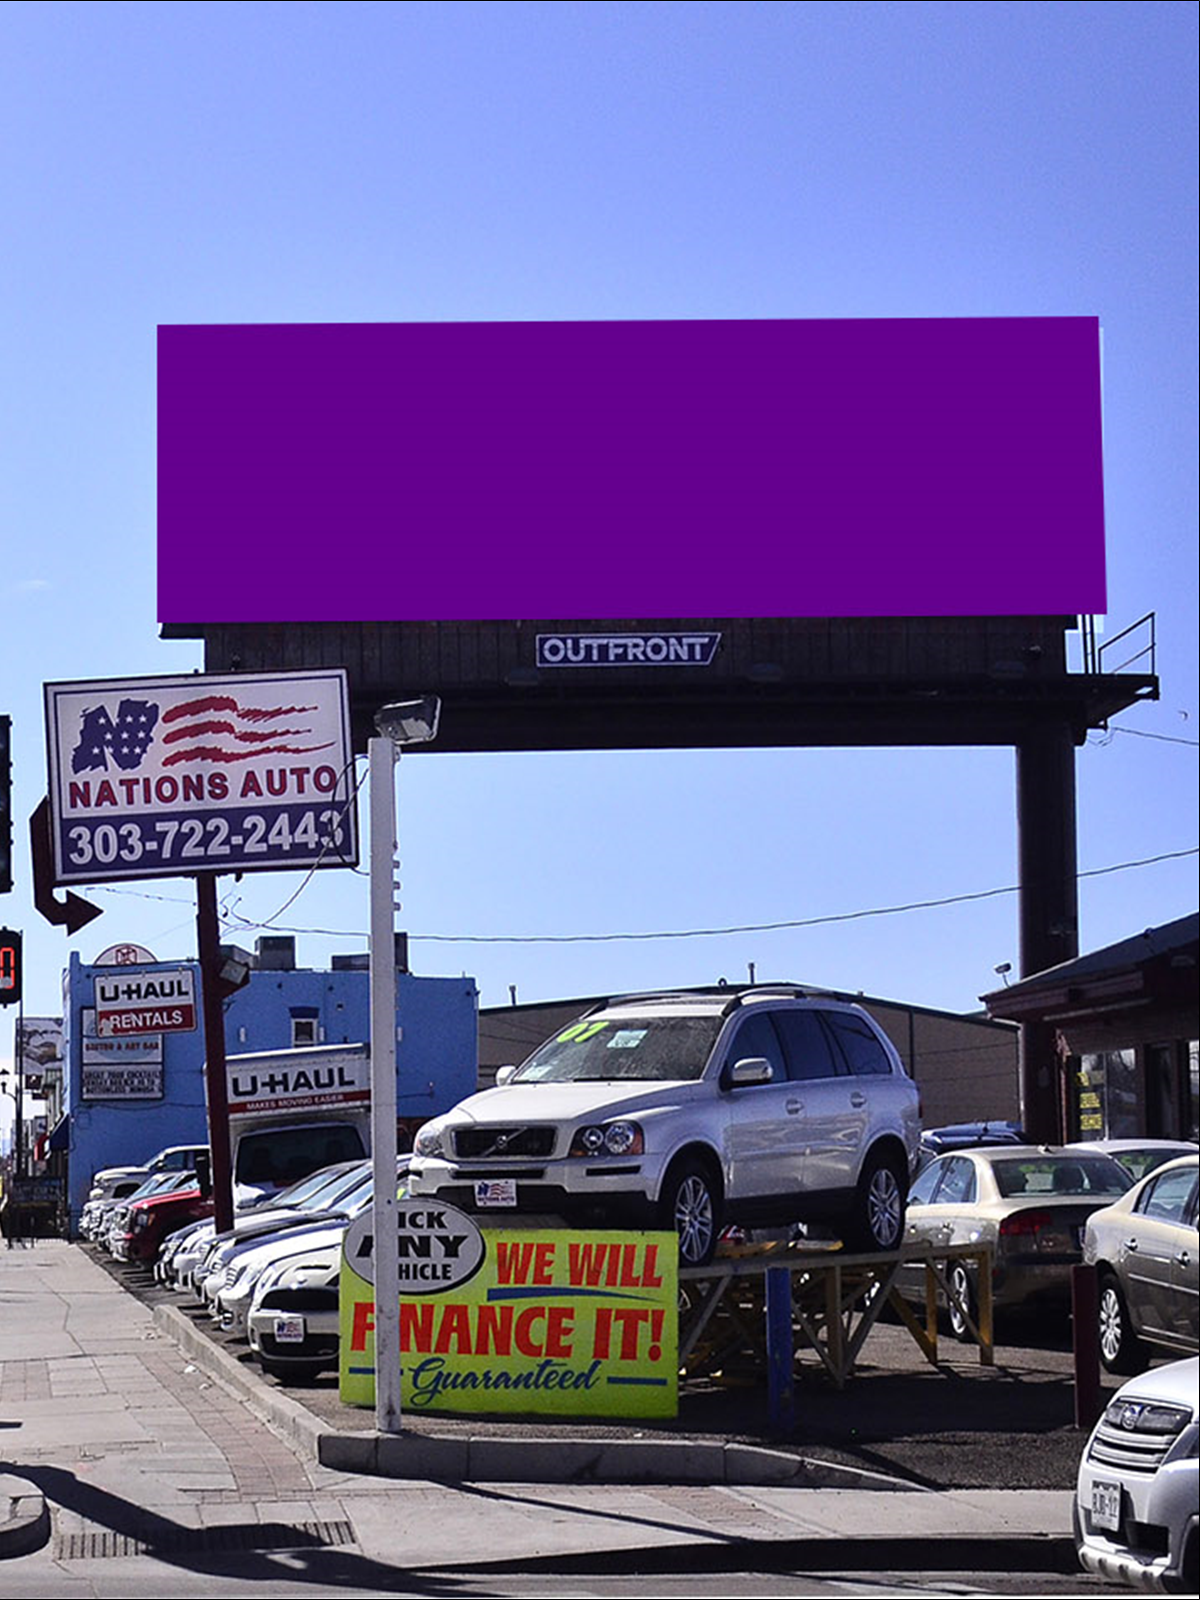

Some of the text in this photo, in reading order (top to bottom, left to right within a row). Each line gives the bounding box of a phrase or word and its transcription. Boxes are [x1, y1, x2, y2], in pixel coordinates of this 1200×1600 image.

[543, 637, 710, 662] OUTFRONT
[69, 766, 337, 808] NATIONS AUTO
[68, 810, 345, 865] 303-722-2443
[100, 980, 190, 1002] U-HAUL
[110, 1009, 183, 1029] RENTALS
[232, 1066, 356, 1097] U-HAUL
[246, 1093, 345, 1111] MAKES MOVING EASIER
[398, 1211, 448, 1229] ICK
[398, 1263, 452, 1280] HICLE
[496, 1242, 663, 1288] WE WILL
[350, 1302, 665, 1362] FNANCE IT!
[408, 1357, 601, 1406] Guaranteed
